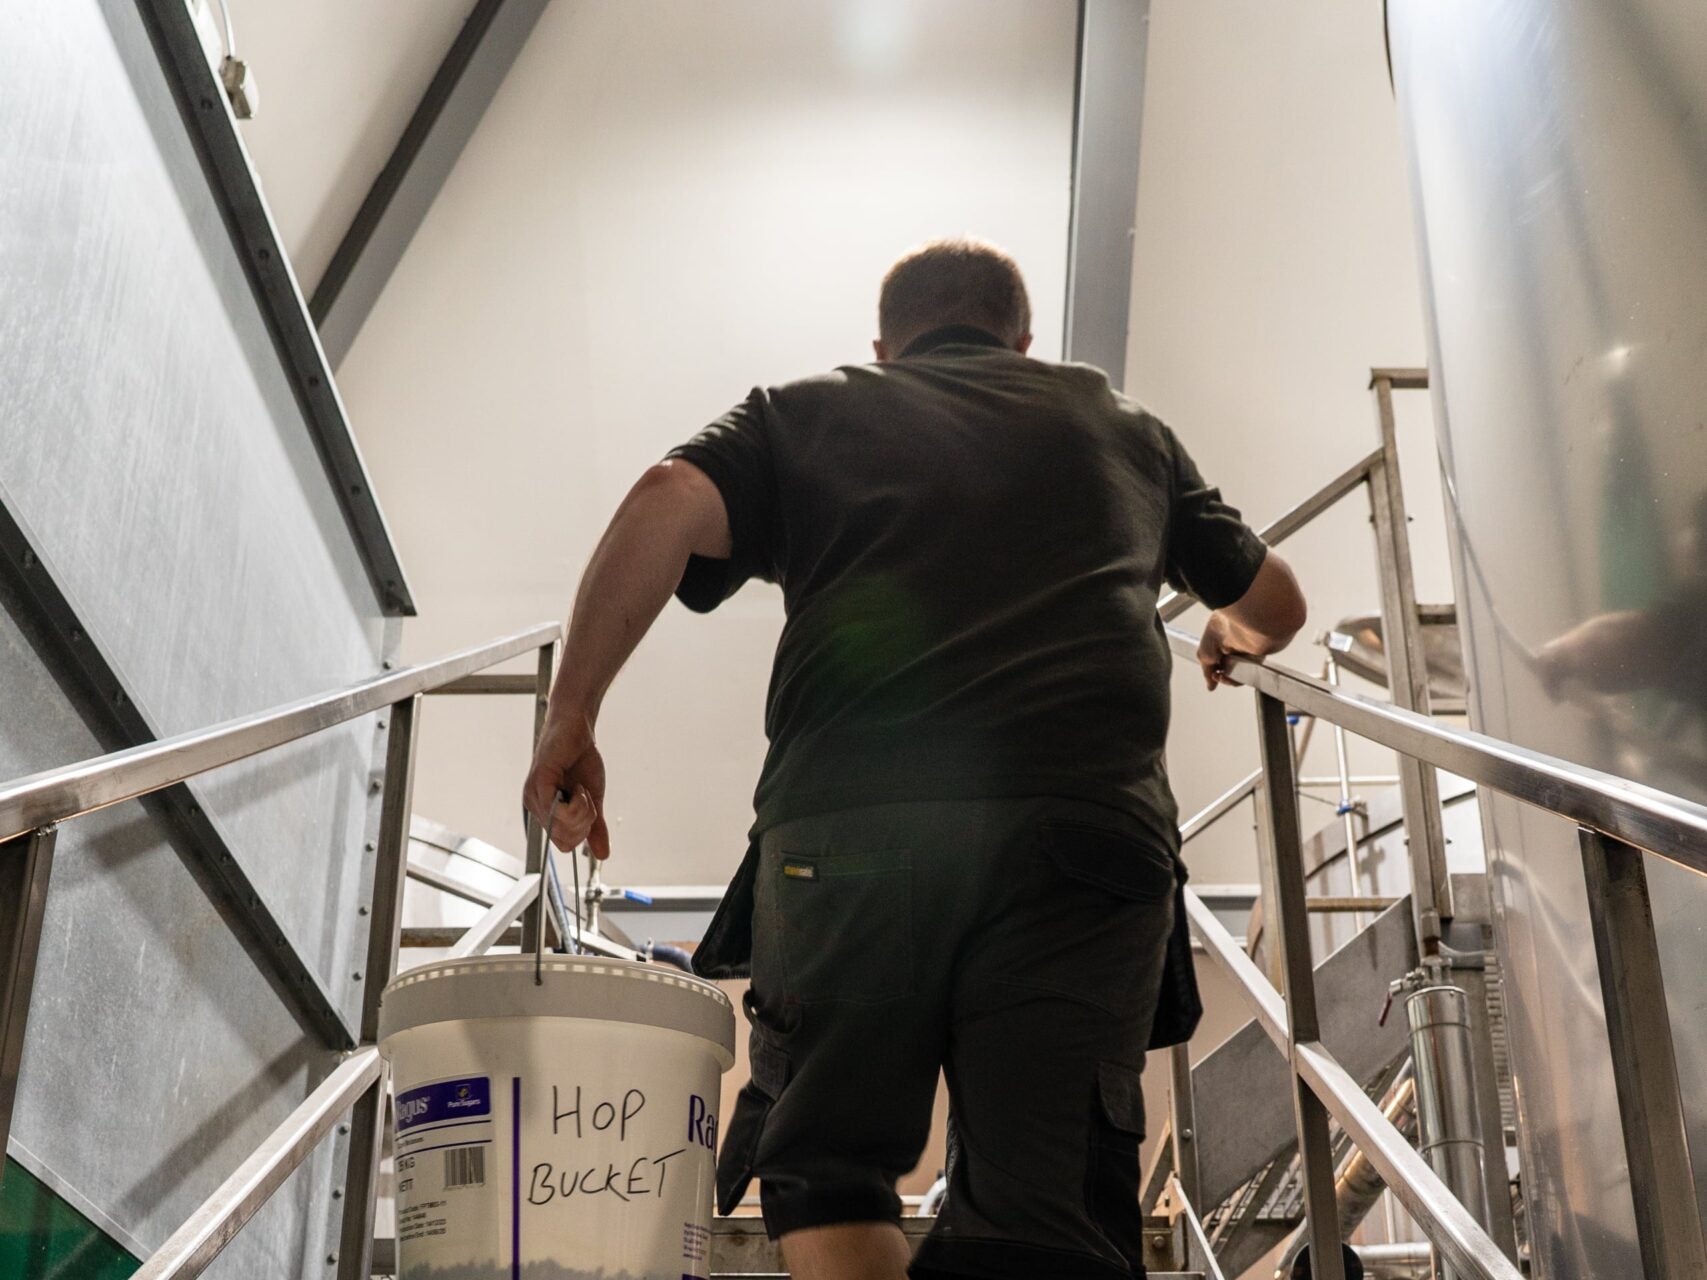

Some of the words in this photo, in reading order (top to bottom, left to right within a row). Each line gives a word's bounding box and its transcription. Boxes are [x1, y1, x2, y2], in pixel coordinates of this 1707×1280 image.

[397, 1098, 428, 1123] agus
[553, 1085, 645, 1141] HOP
[688, 1094, 718, 1153] Ra
[528, 1149, 686, 1205] BUCKET
